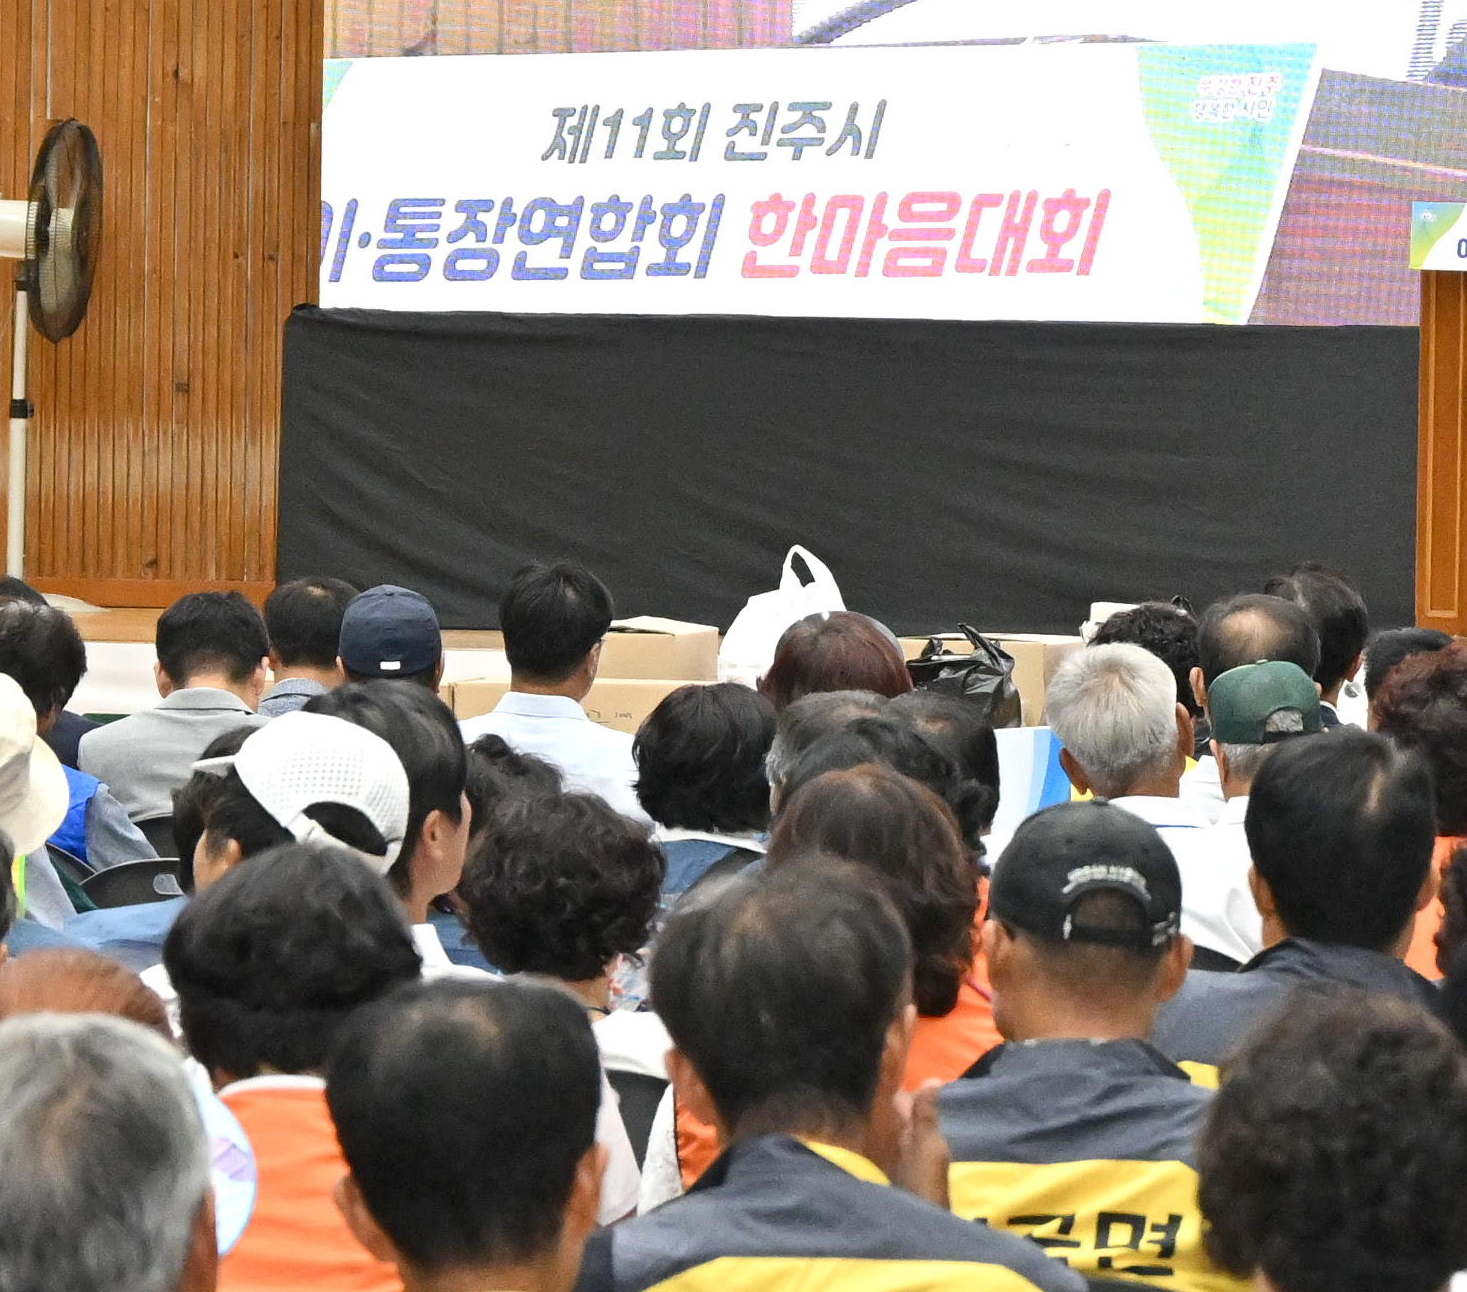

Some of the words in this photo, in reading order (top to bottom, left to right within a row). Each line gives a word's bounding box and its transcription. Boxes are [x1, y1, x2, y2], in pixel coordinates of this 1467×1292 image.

[542, 101, 710, 164] 제11회
[721, 99, 887, 163] 진주시
[739, 188, 1111, 279] 한마음대회
